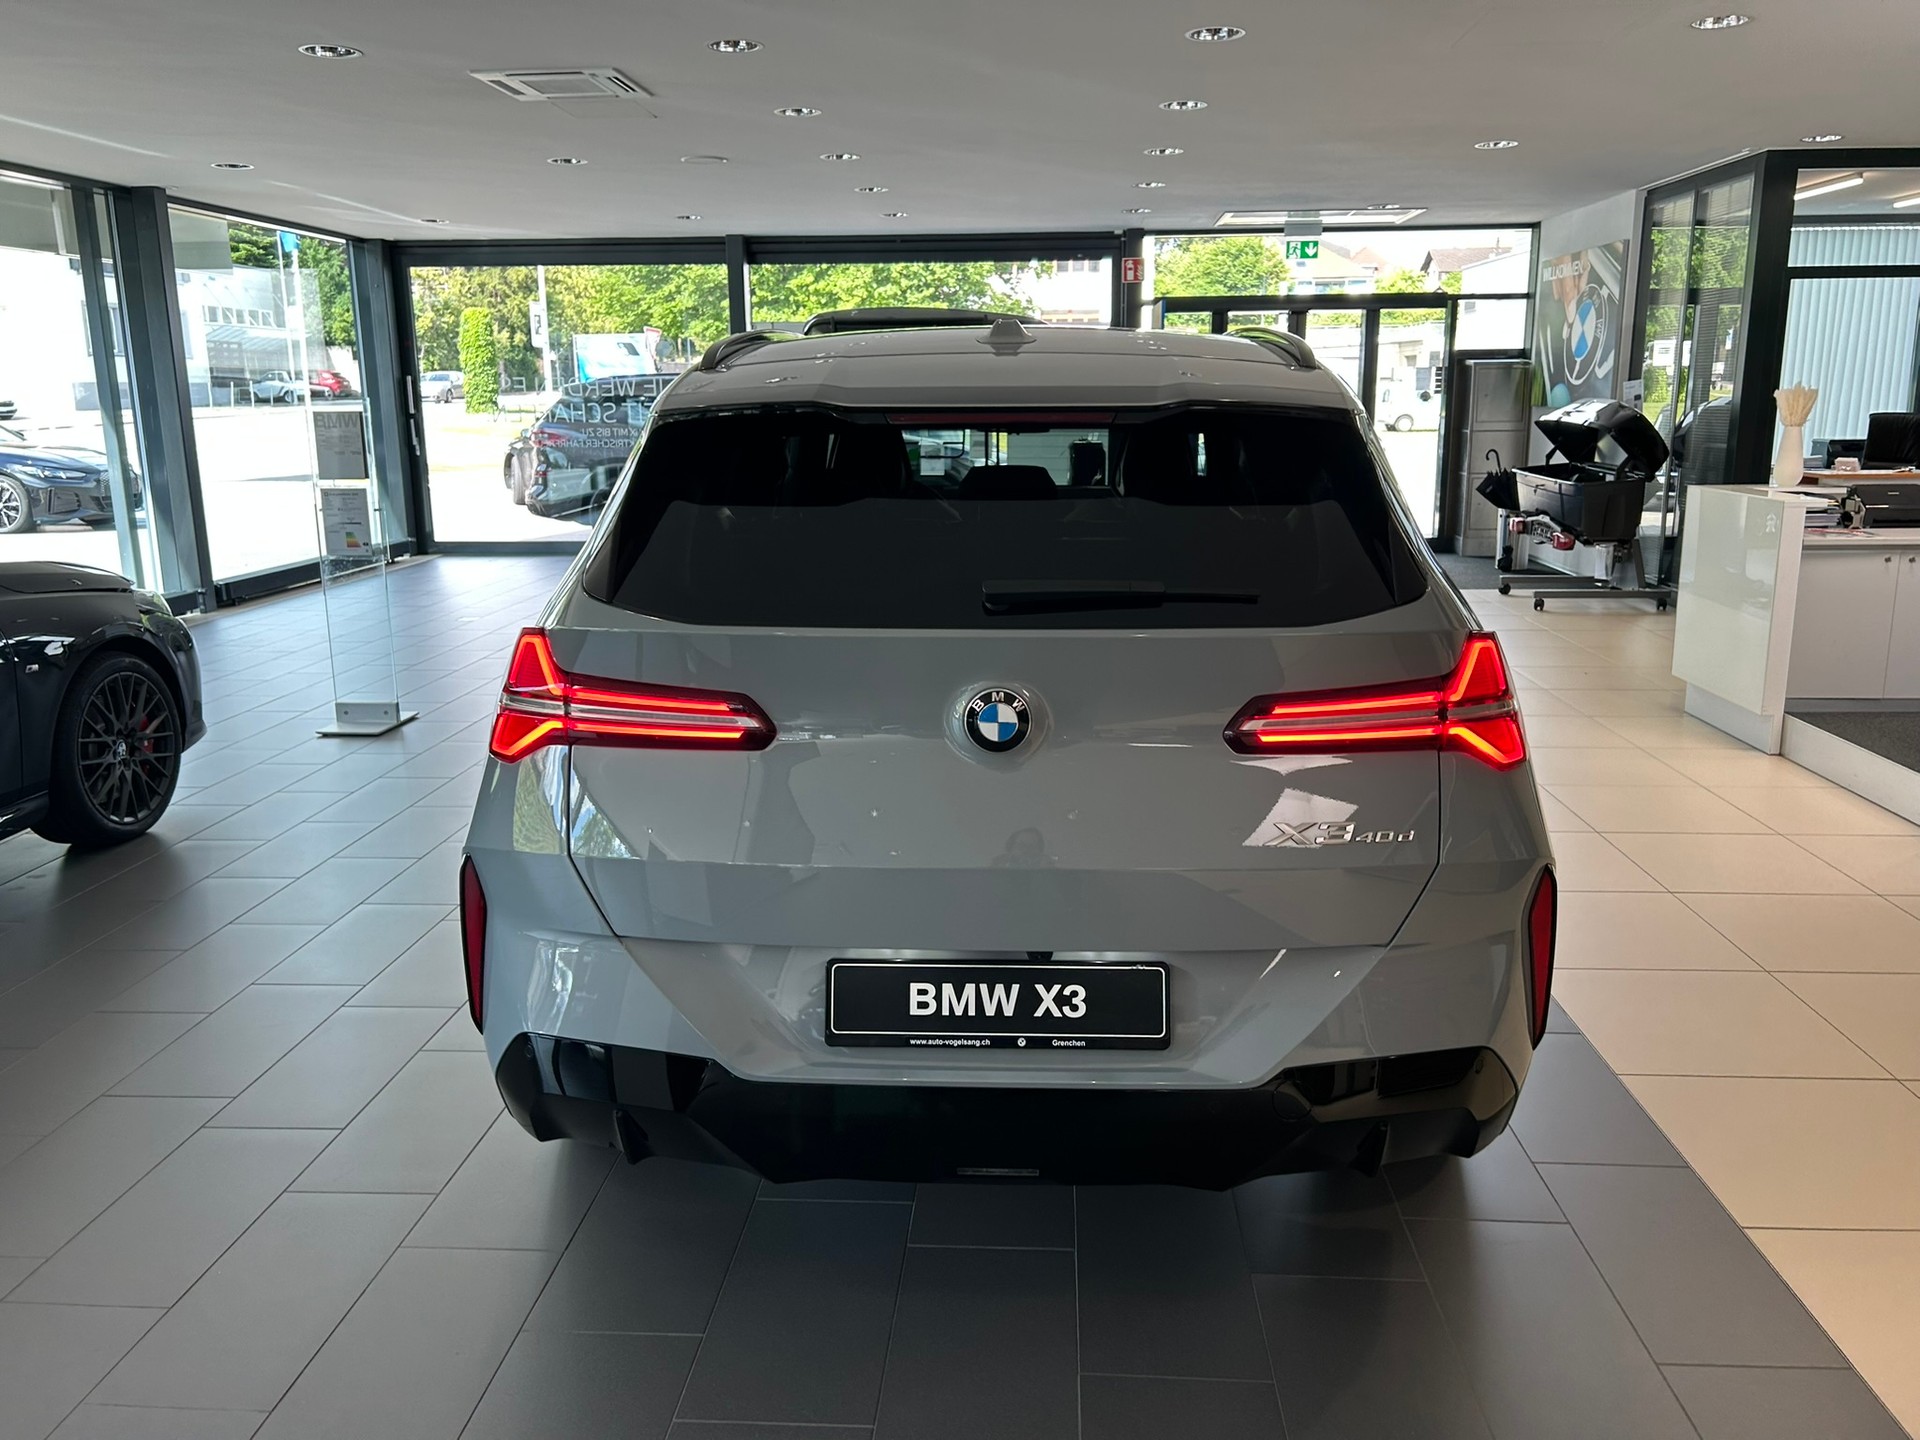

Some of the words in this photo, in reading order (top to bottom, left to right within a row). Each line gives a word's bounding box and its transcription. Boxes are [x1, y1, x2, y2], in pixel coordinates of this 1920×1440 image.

[1542, 260, 1584, 282] WILLKOMMEN
[971, 691, 1026, 713] BMW
[1262, 821, 1357, 846] X3
[909, 982, 1020, 1017] BMW
[1033, 983, 1087, 1019] X3
[909, 1038, 991, 1048] www.auto-vogelsang.ch
[1051, 1039, 1086, 1047] Grenchen
